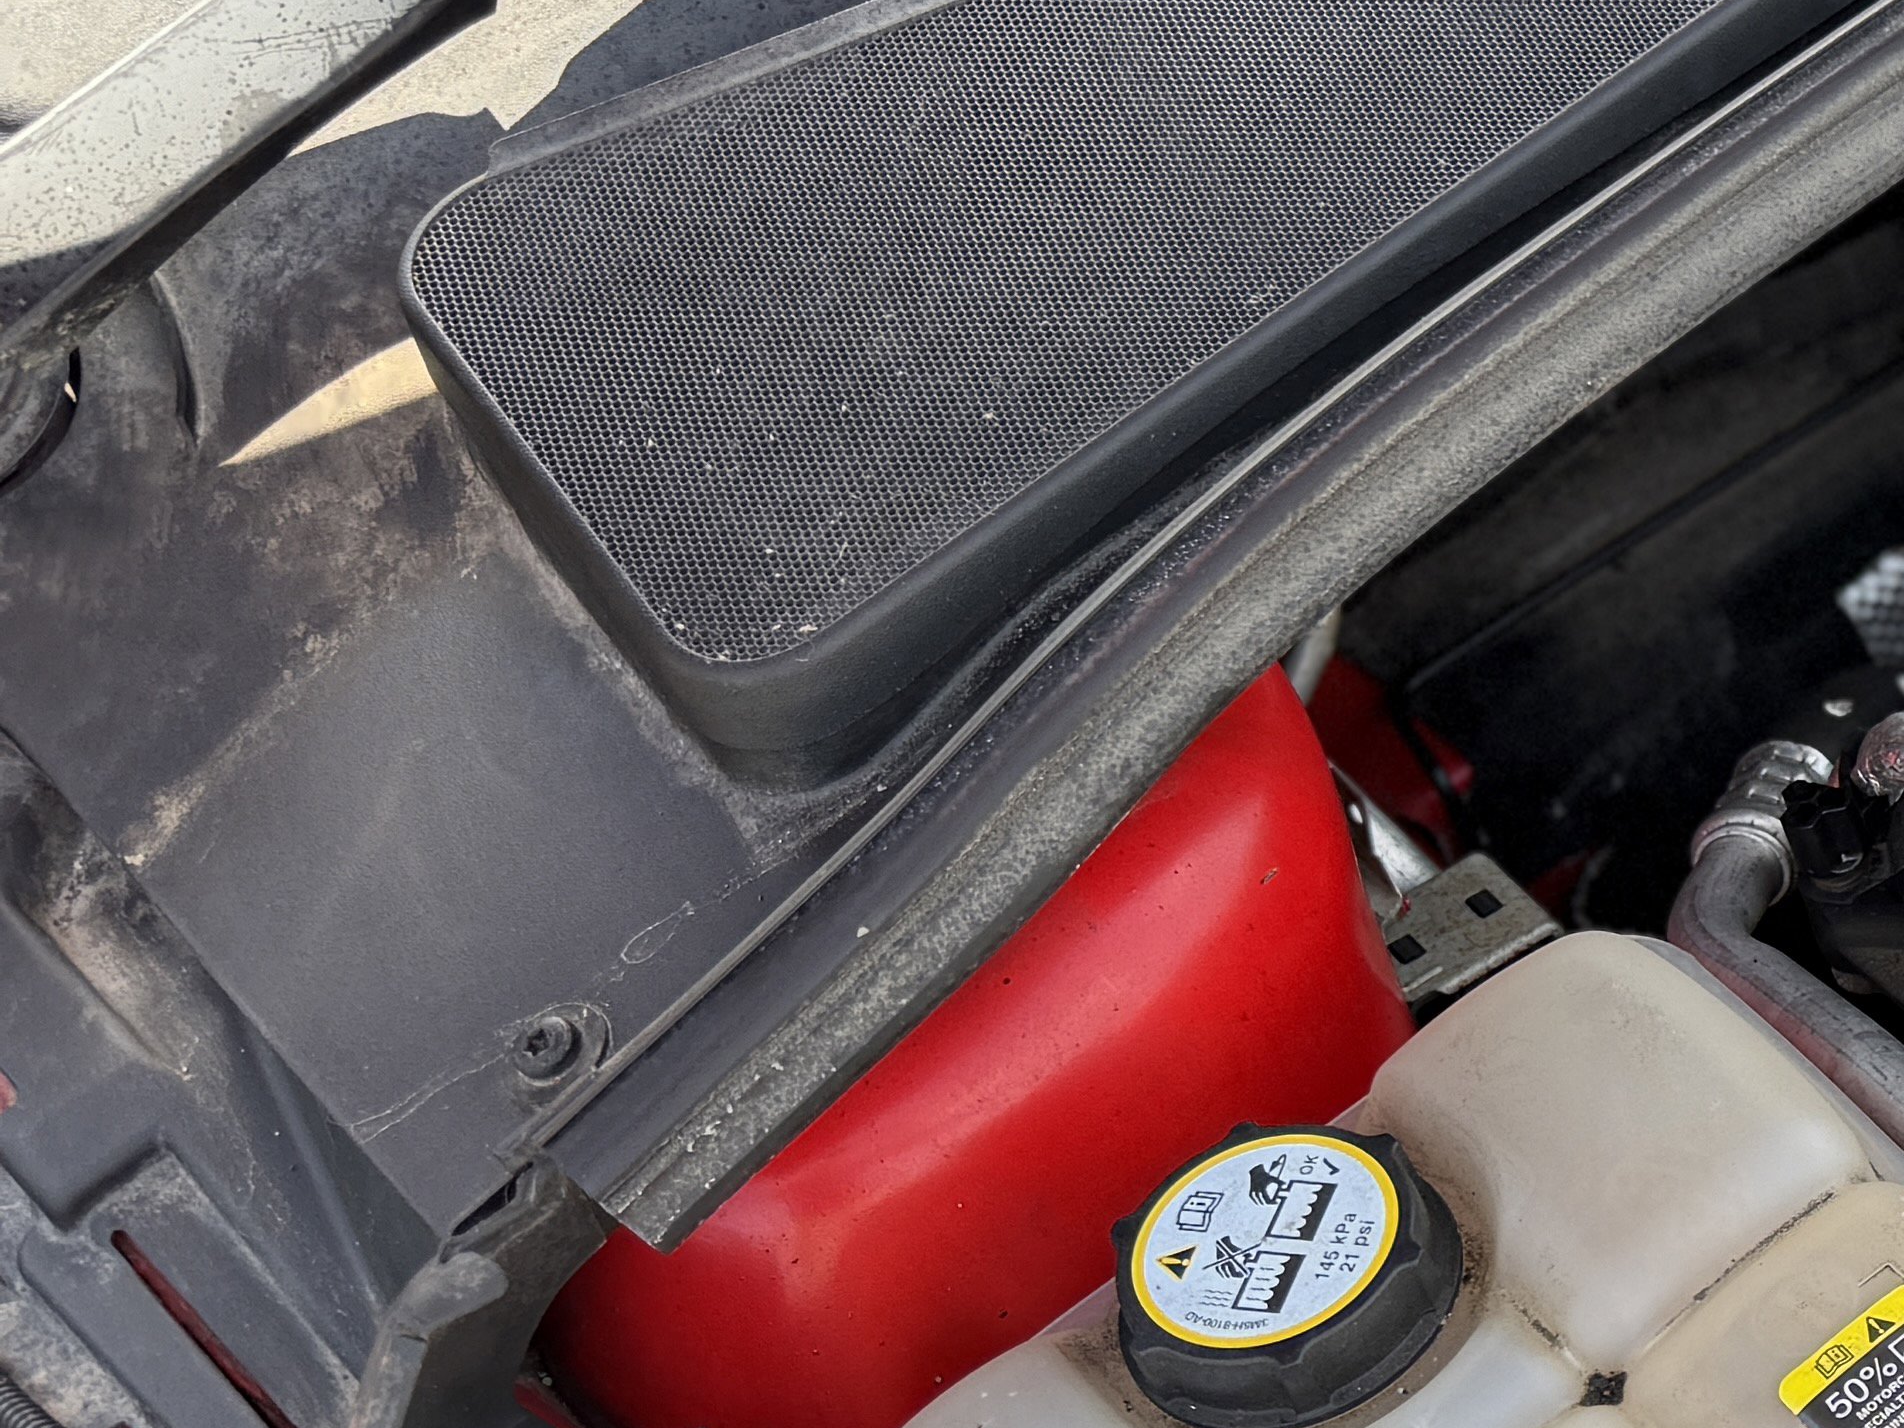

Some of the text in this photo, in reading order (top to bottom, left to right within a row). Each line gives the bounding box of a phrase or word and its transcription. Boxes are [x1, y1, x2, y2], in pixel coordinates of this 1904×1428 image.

[1300, 1155, 1319, 1175] OK
[1315, 1213, 1358, 1280] 145 kPa
[1340, 1220, 1375, 1273] 21 psi
[1825, 1357, 1898, 1420] 50%
